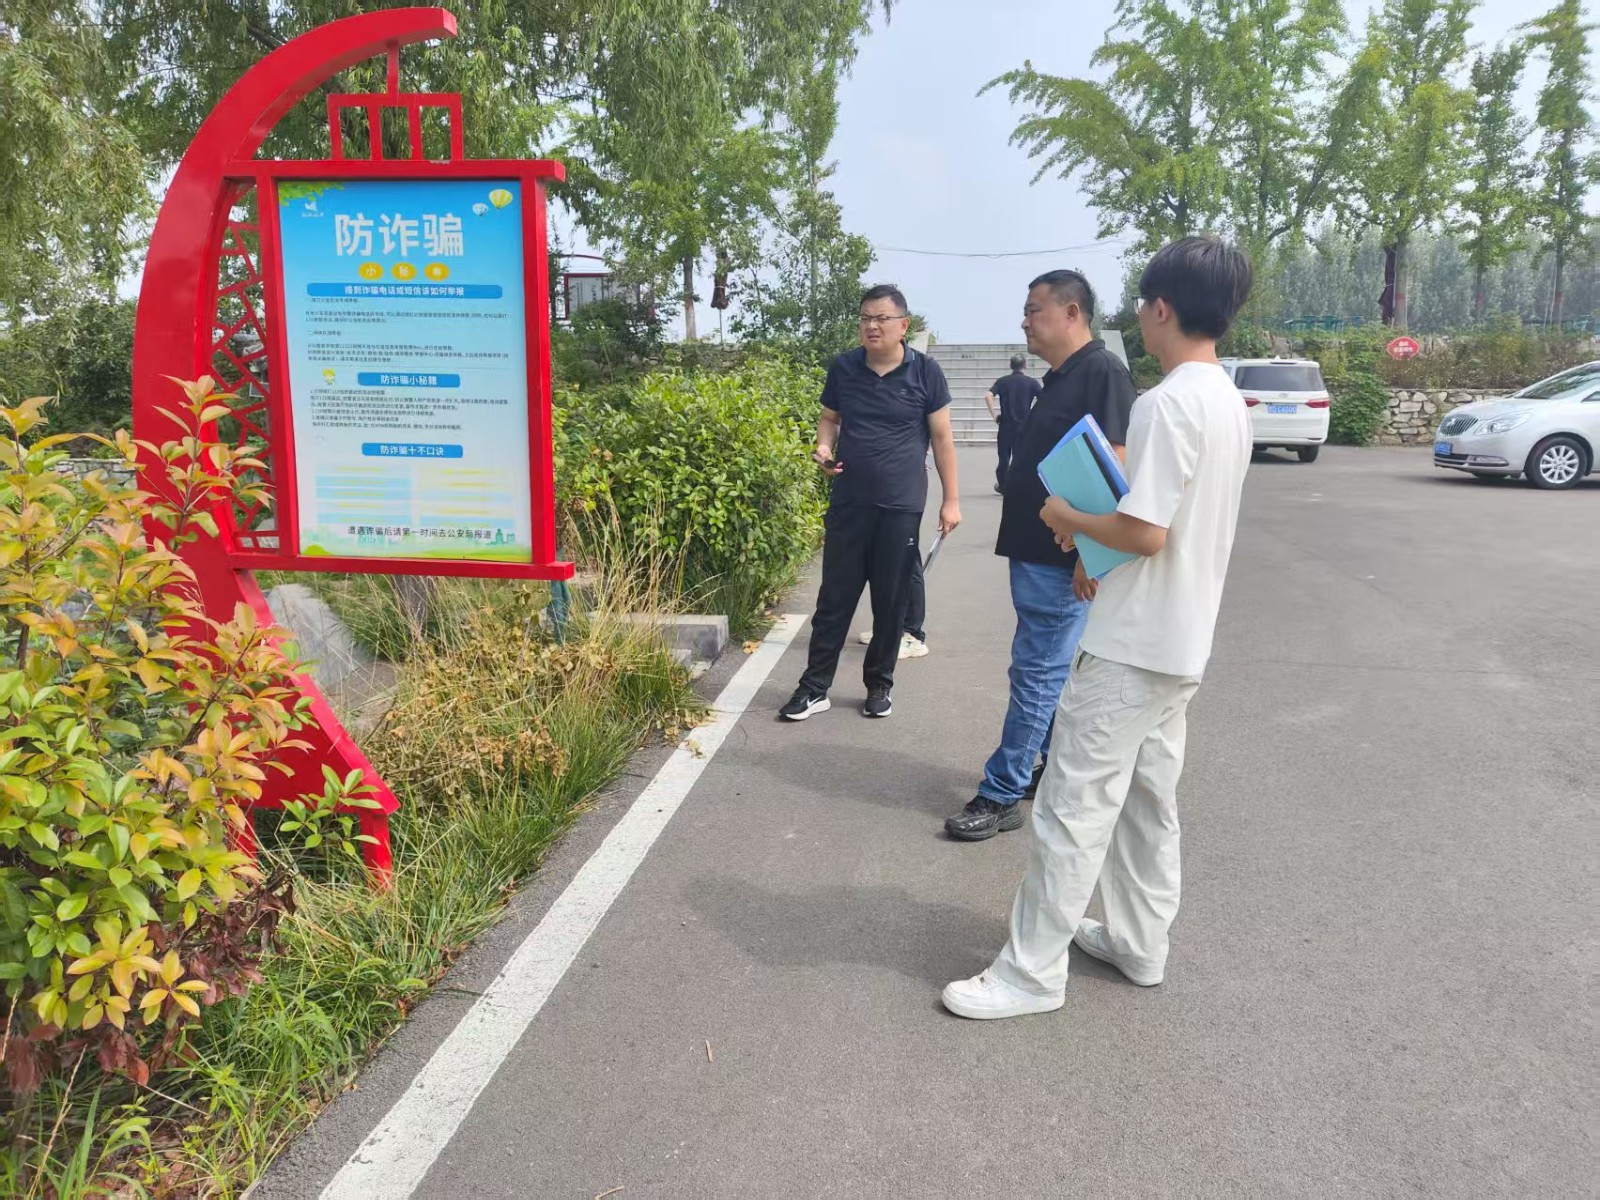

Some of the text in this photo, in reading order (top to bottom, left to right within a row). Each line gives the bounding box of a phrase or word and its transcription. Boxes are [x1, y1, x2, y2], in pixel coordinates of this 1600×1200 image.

[334, 213, 464, 257] 防诈骗
[380, 444, 445, 456] 防诈骗十不口诀
